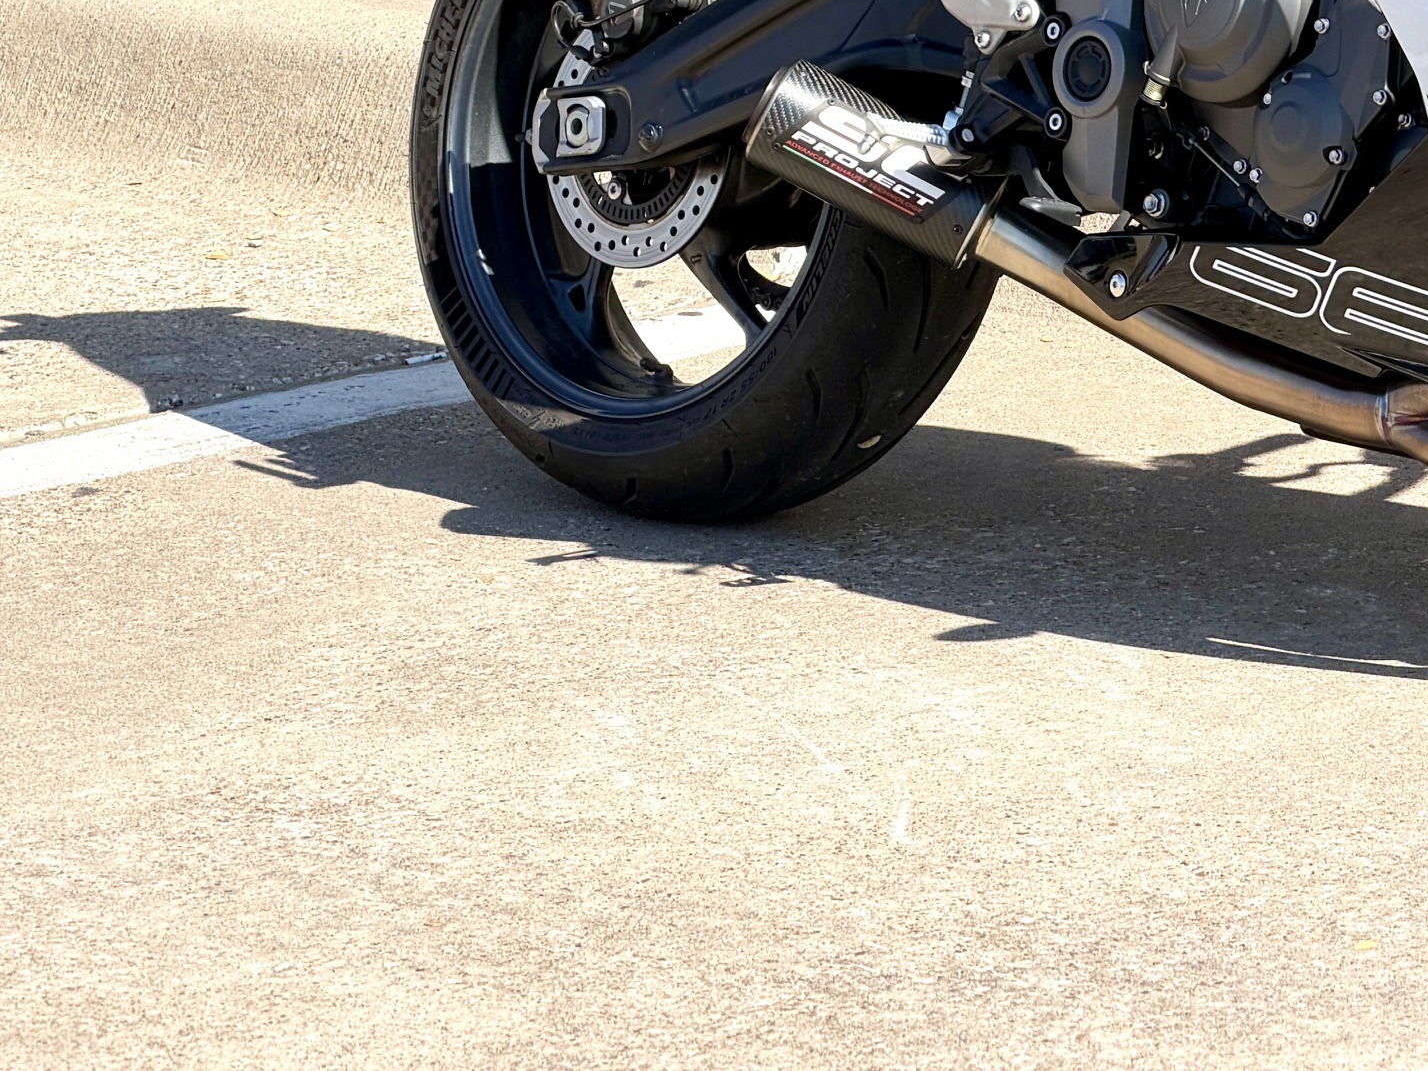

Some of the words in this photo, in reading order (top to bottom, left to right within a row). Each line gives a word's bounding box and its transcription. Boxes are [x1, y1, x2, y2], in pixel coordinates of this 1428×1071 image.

[785, 140, 830, 167] ADVANCED
[830, 163, 868, 187] EXHAUST
[868, 181, 923, 213] TECHNOLOGY
[791, 131, 934, 206] PROJECT
